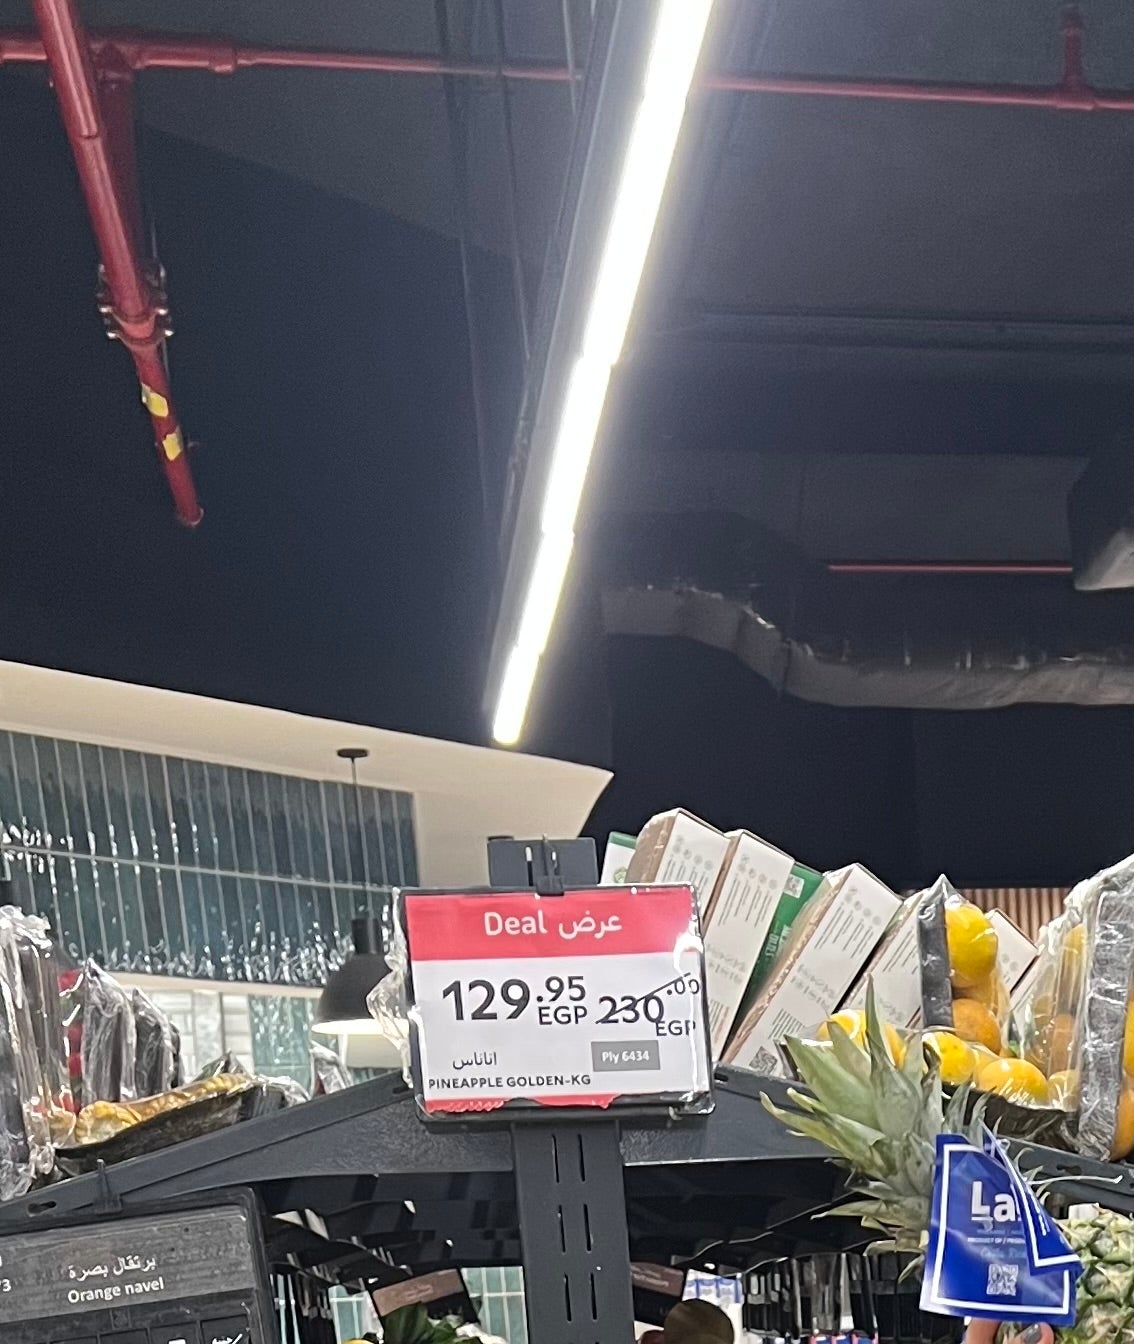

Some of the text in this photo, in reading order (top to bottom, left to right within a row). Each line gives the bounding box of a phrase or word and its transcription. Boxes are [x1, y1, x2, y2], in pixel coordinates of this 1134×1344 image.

[483, 911, 548, 936] Deal
[558, 910, 623, 939] عرض
[538, 1006, 588, 1026] EGP
[655, 1019, 696, 1037] EGP
[601, 1050, 650, 1064] Ply 6434
[428, 1073, 591, 1090] PINEAPPLE GOLDEN-KG
[972, 1181, 1022, 1222] La
[0, 1278, 12, 1292] 3
[68, 1276, 165, 1303] Orange navel
